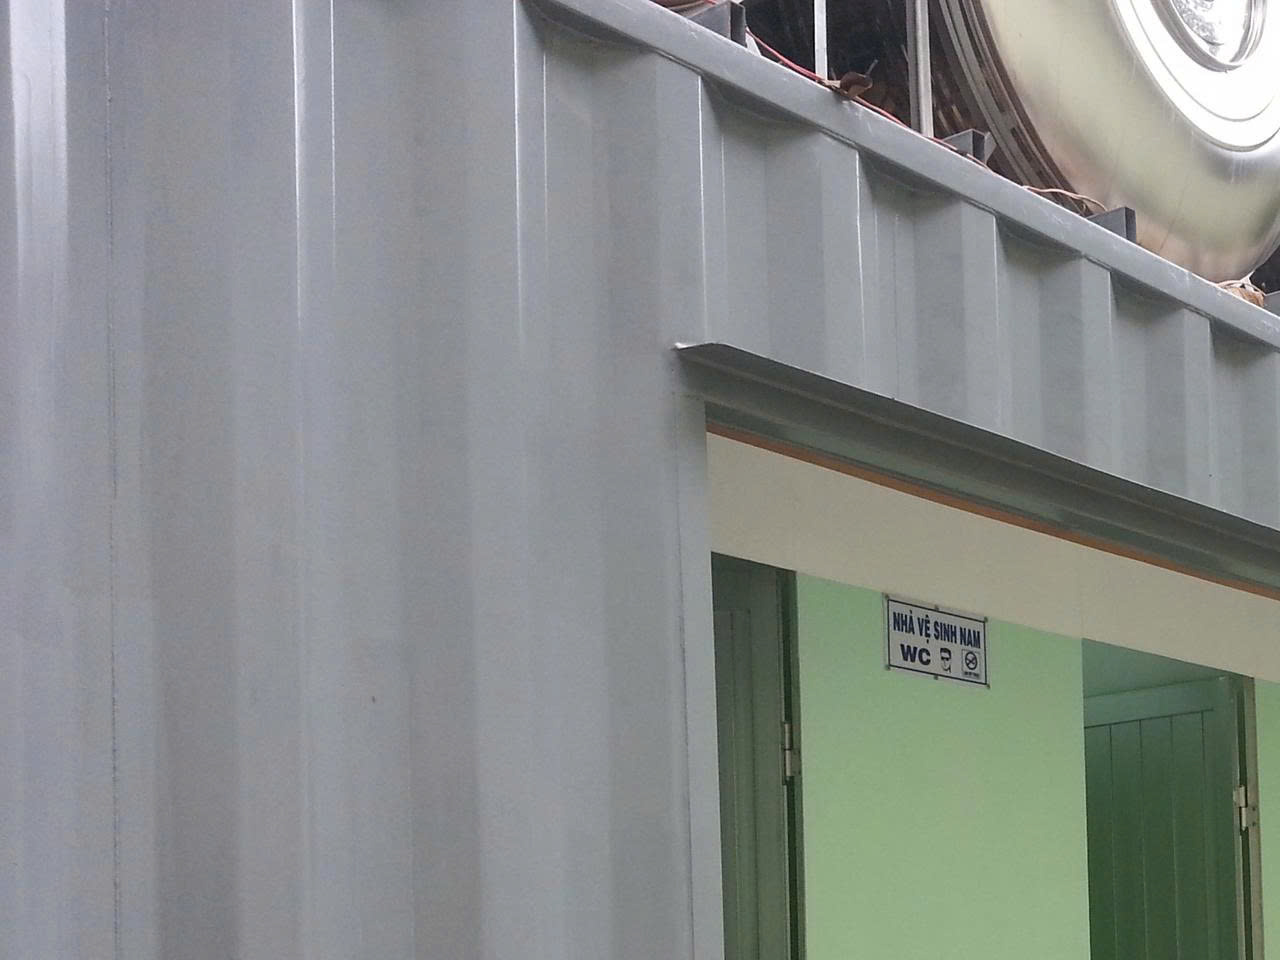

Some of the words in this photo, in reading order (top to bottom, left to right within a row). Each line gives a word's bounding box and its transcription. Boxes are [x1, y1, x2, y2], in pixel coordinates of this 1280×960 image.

[892, 609, 915, 635] NHÀ
[917, 614, 931, 643] VỆ
[933, 620, 957, 644] SINH
[960, 626, 981, 649] NAM
[900, 643, 931, 666] WC
